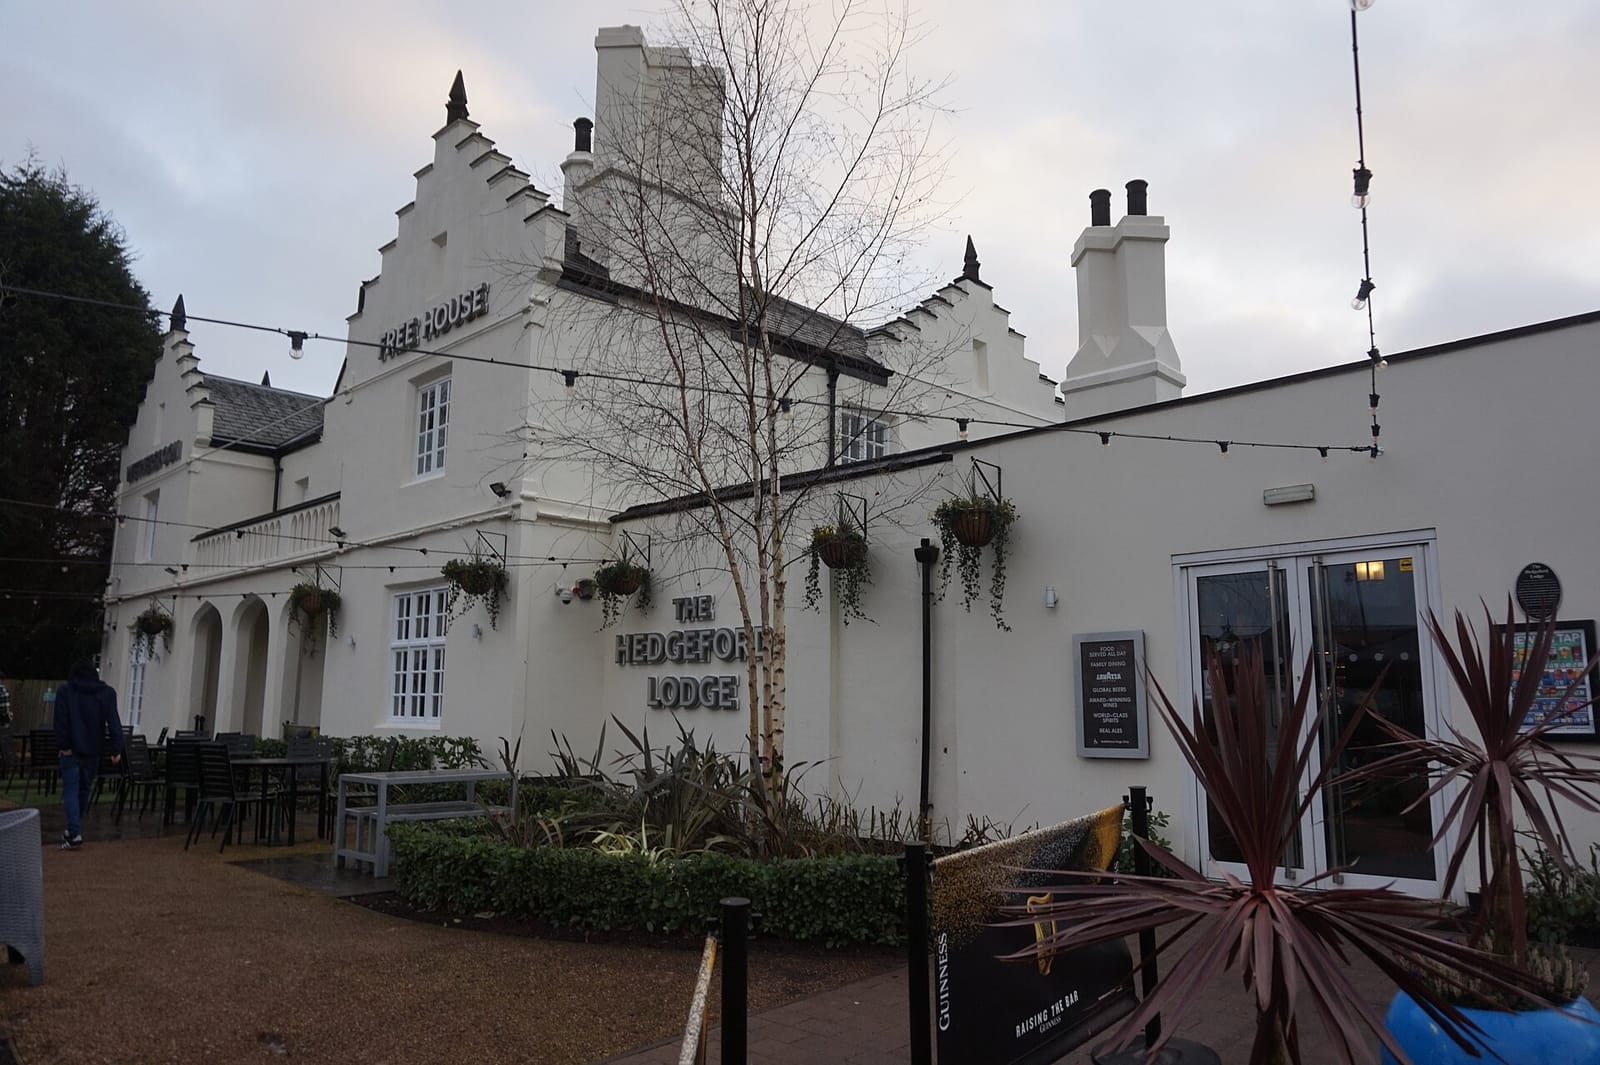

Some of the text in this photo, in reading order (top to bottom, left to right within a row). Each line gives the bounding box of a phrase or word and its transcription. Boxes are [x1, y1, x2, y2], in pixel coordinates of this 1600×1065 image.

[378, 282, 490, 361] FREE HOUSE
[672, 594, 716, 623] THE
[1556, 633, 1580, 642] TAP
[647, 675, 740, 711] LODGE
[938, 932, 950, 1032] GUINNESS
[1015, 1009, 1048, 1039] RAISING
[1051, 999, 1064, 1017] THE
[1065, 990, 1079, 1008] BAR
